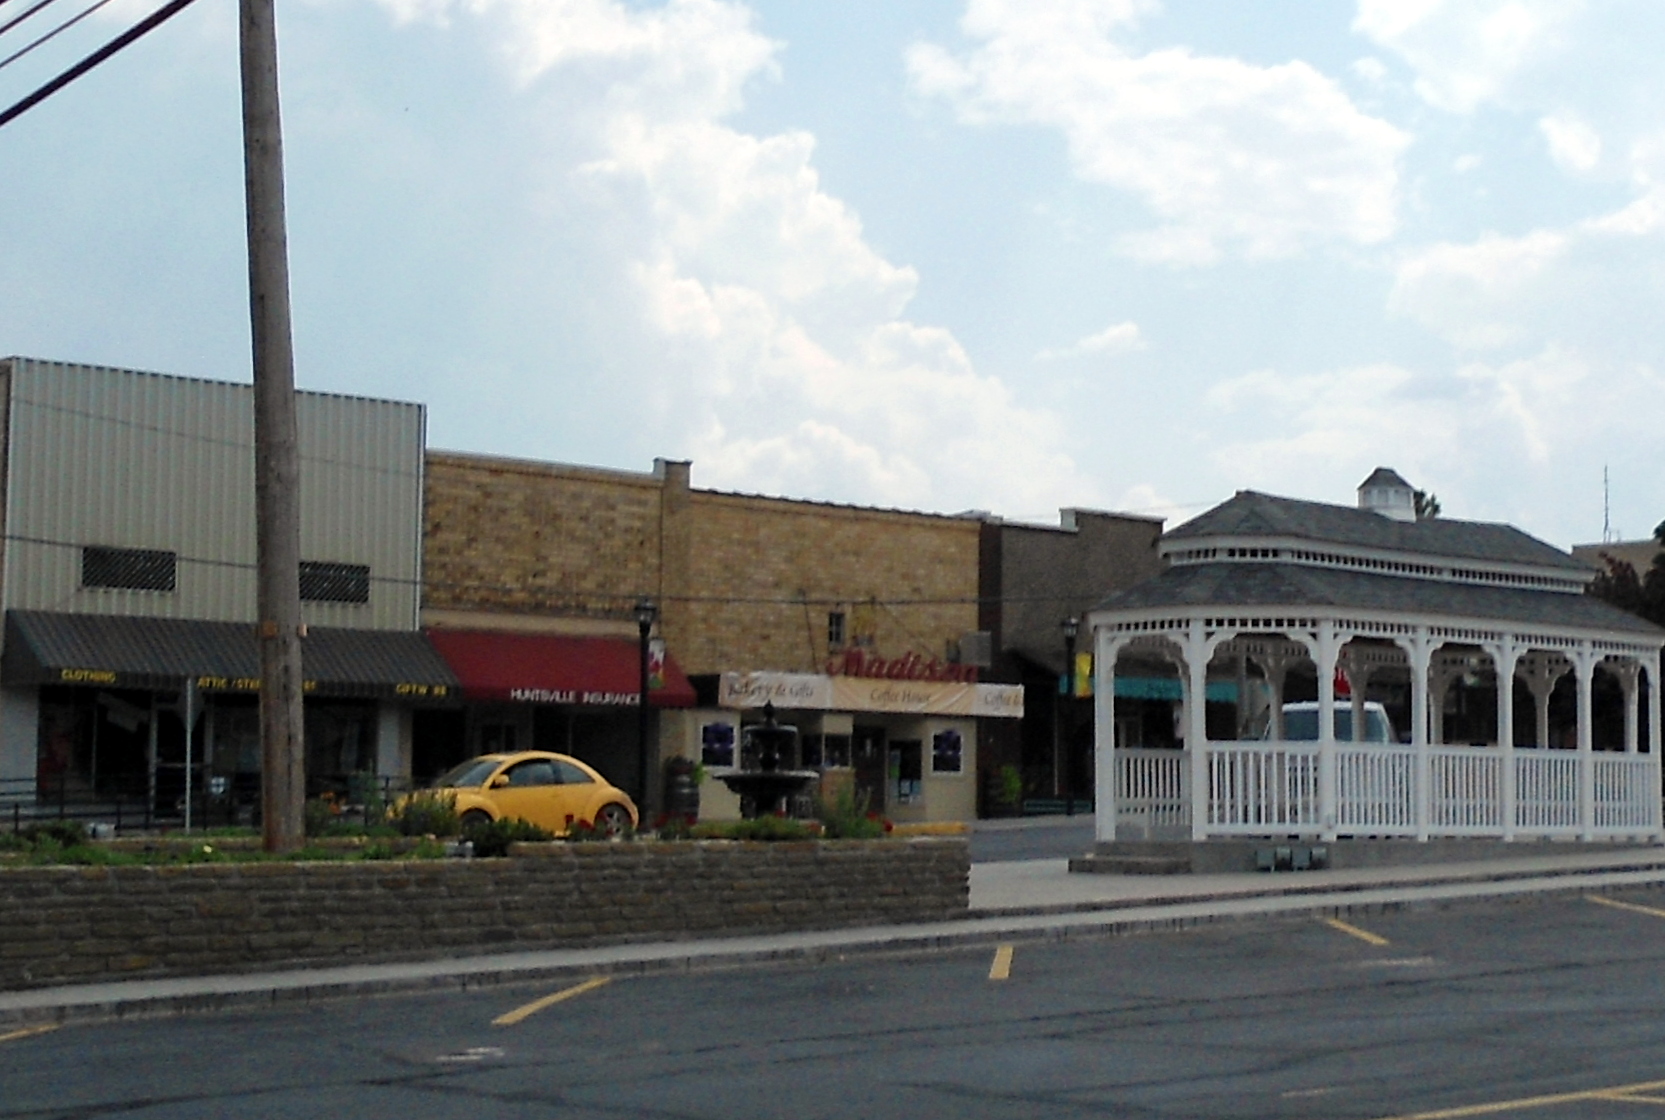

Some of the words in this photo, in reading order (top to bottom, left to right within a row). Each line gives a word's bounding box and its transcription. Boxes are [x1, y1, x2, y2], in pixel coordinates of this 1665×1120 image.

[826, 648, 979, 682] Madison
[61, 669, 117, 684] CLOTHING
[197, 676, 227, 690] ATTIC
[510, 688, 576, 704] HUNTSVILLE
